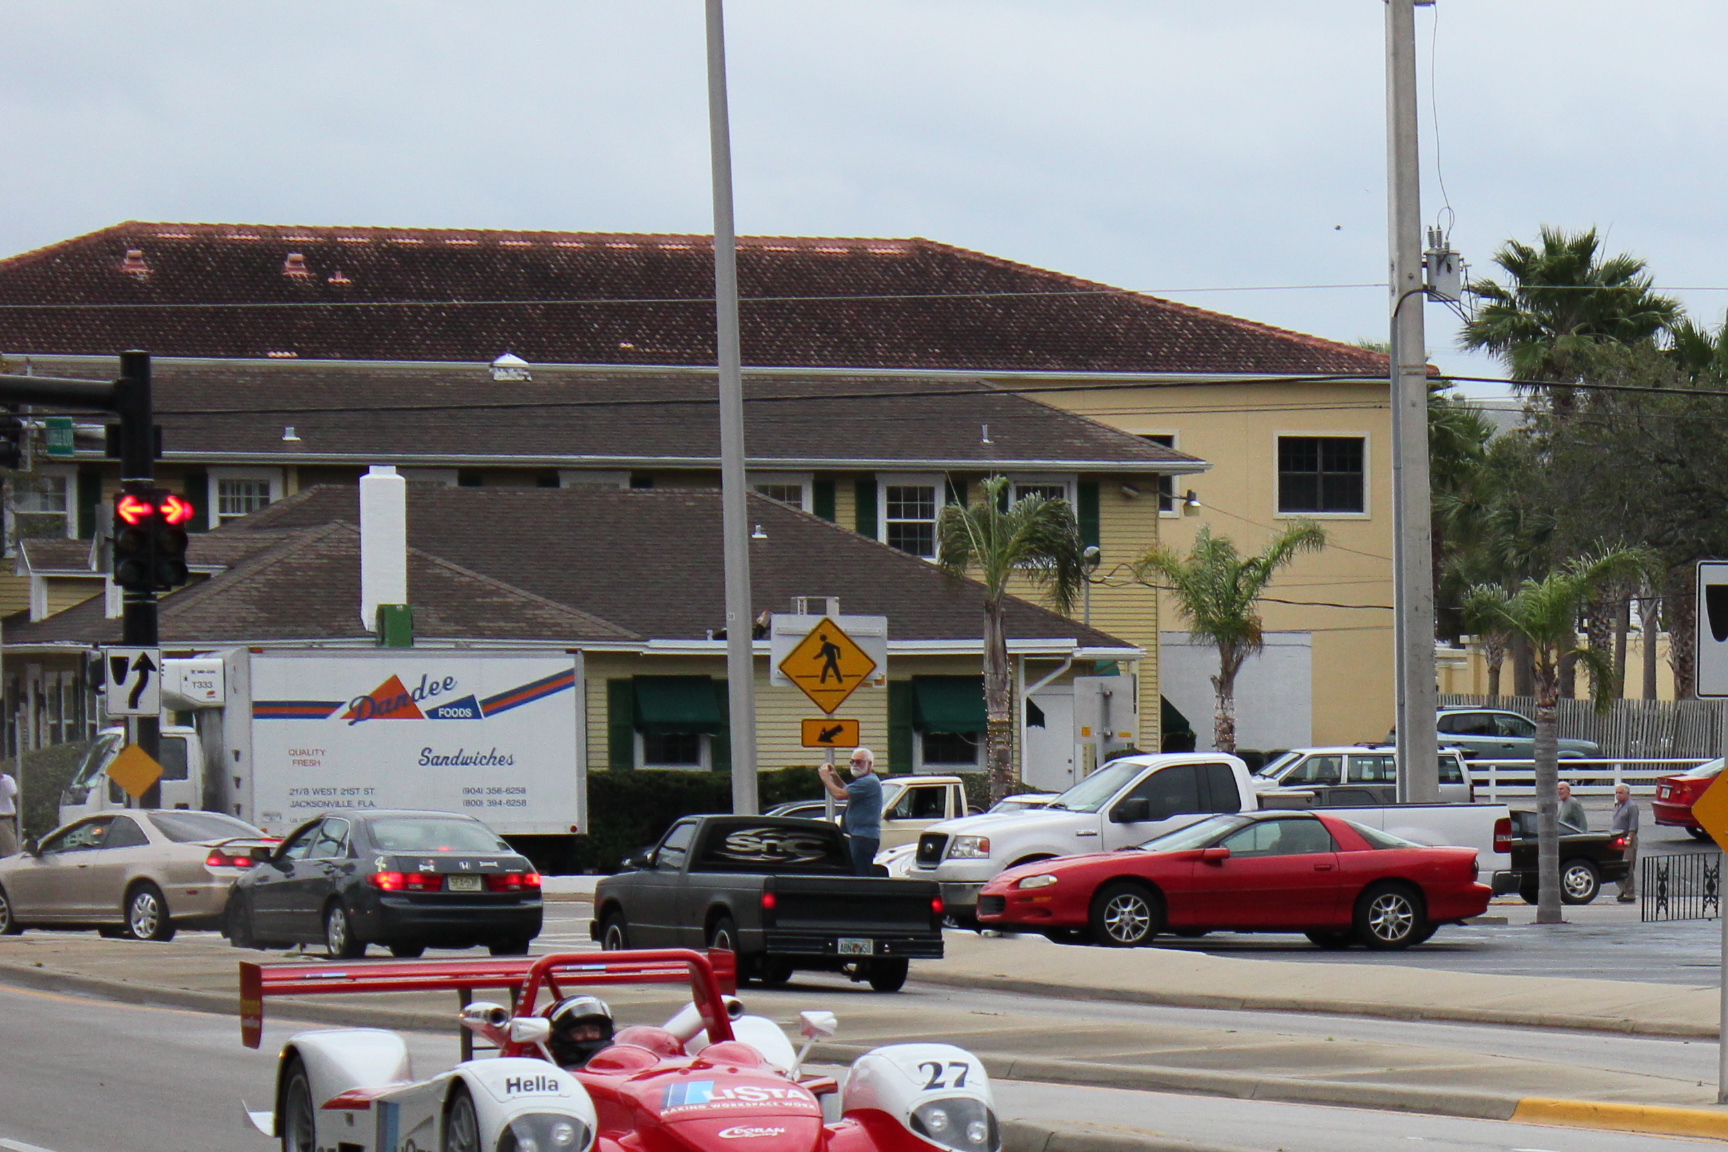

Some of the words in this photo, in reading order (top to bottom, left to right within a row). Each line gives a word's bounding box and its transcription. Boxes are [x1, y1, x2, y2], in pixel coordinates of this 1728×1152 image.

[192, 681, 213, 689] T333
[348, 673, 457, 726] Dandee
[438, 707, 473, 718] FOODS
[288, 748, 326, 757] QUALITY
[418, 747, 515, 766] Sandwiches
[292, 759, 321, 767] FRESH
[311, 787, 338, 796] WEST
[340, 787, 360, 796] 21ST
[917, 1061, 969, 1091] 27
[506, 1075, 559, 1094] Hella
[701, 1085, 811, 1102] LISTA
[660, 1103, 707, 1116] MAKING
[711, 1101, 779, 1110] WORKSPACE
[782, 1101, 816, 1110] WORK
